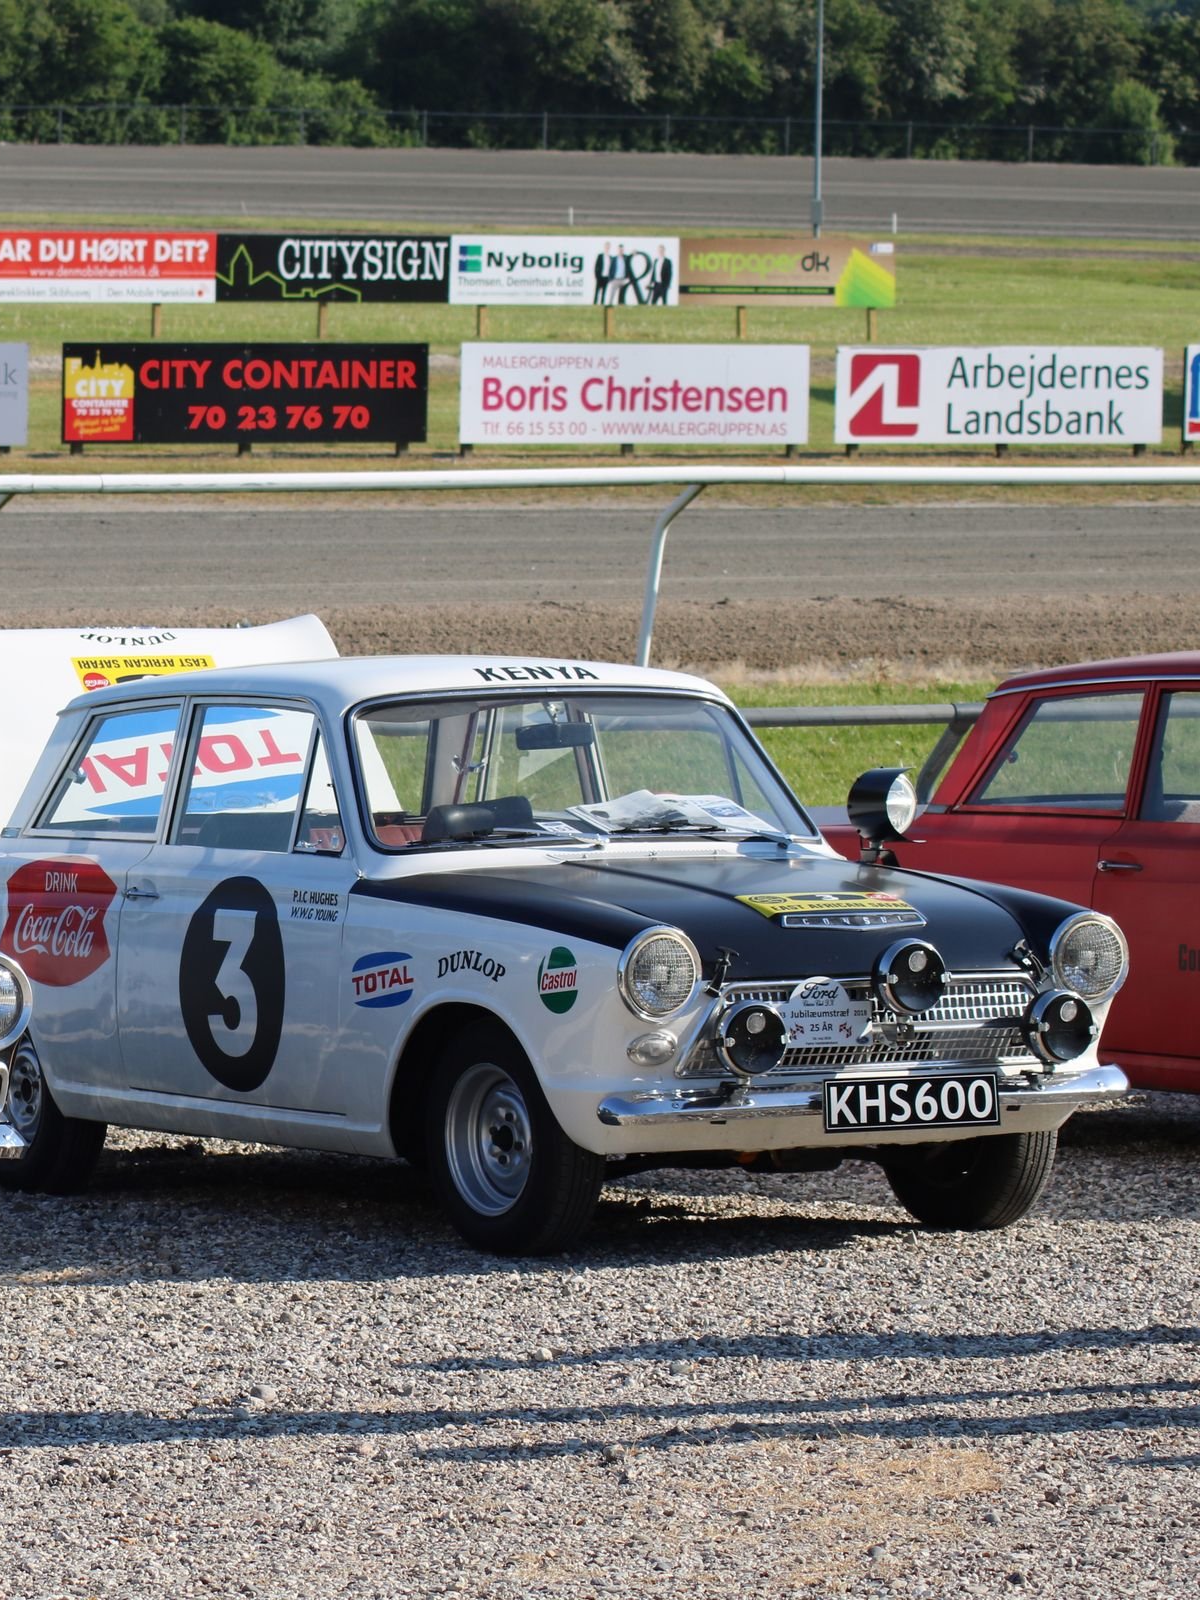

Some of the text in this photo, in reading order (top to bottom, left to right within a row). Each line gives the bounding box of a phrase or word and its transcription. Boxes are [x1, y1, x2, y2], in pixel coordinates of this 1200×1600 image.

[39, 238, 74, 262] DU
[80, 238, 147, 262] HØRT
[154, 239, 209, 263] DET?
[278, 239, 448, 280] CITYSIGN
[487, 252, 584, 273] Nybolig
[458, 277, 504, 288] Thomsen,
[483, 357, 619, 369] MALERGRUPPEN A/S
[140, 360, 416, 389] CITY CONTAINER
[947, 354, 1150, 398] Arbejdernes
[76, 380, 125, 397] CITY
[482, 376, 787, 412] Boris Christensen
[72, 399, 128, 408] CONTAINER
[188, 406, 370, 430] 70 23 76 70
[947, 400, 1125, 435] Landsbank
[506, 422, 525, 435] 66
[529, 422, 544, 435] 15
[548, 422, 565, 435] 53
[569, 422, 587, 435] 00
[602, 422, 787, 436] WWW.MALERGRUPPEN.AS
[80, 632, 178, 646] DUNLOP
[77, 658, 208, 669] EAST AFRICAN SAFARI
[473, 666, 600, 682] KENYA
[45, 871, 78, 893] DRINK
[309, 891, 338, 906] HUGHES
[810, 902, 864, 910] AFRICAN
[291, 906, 339, 922] W.W.G YOUNG
[803, 916, 904, 925] CONSUL
[13, 903, 100, 958] Coca-Cola
[437, 950, 506, 983] DUNLOP
[207, 909, 258, 1057] 3
[352, 966, 414, 996] TOTAL
[541, 969, 577, 992] Castrol
[800, 982, 839, 1000] Ford
[790, 1009, 849, 1018] Jubilæumstræf
[822, 1021, 833, 1031] ÅR
[830, 1079, 993, 1125] KHS600
